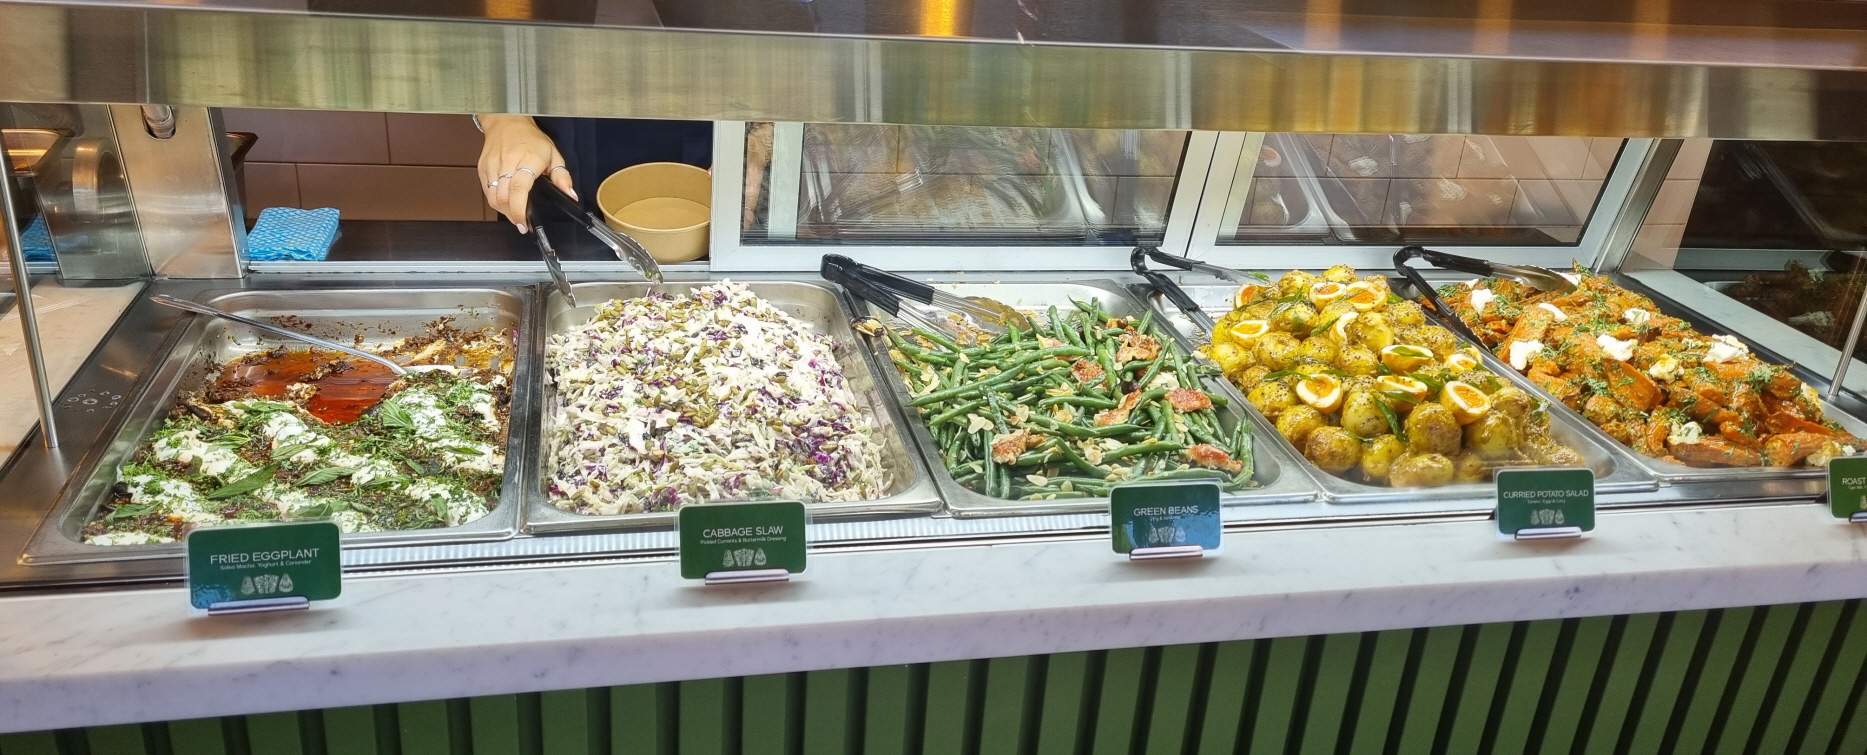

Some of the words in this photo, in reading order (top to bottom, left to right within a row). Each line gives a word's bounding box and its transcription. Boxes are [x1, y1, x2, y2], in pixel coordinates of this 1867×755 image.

[1842, 477, 1867, 486] ROAST
[1503, 491, 1536, 499] CURRIED
[1537, 490, 1564, 498] POTATO
[1566, 489, 1589, 497] SALAD
[1133, 507, 1166, 517] GREEN
[1168, 505, 1199, 515] BEANS
[703, 527, 752, 538] CABBAGE
[755, 525, 783, 535] SLAW
[210, 553, 249, 565] FRIED
[252, 548, 320, 562] EGGPLANT
[257, 561, 279, 569] Yoghurt
[285, 559, 311, 567] Coriander
